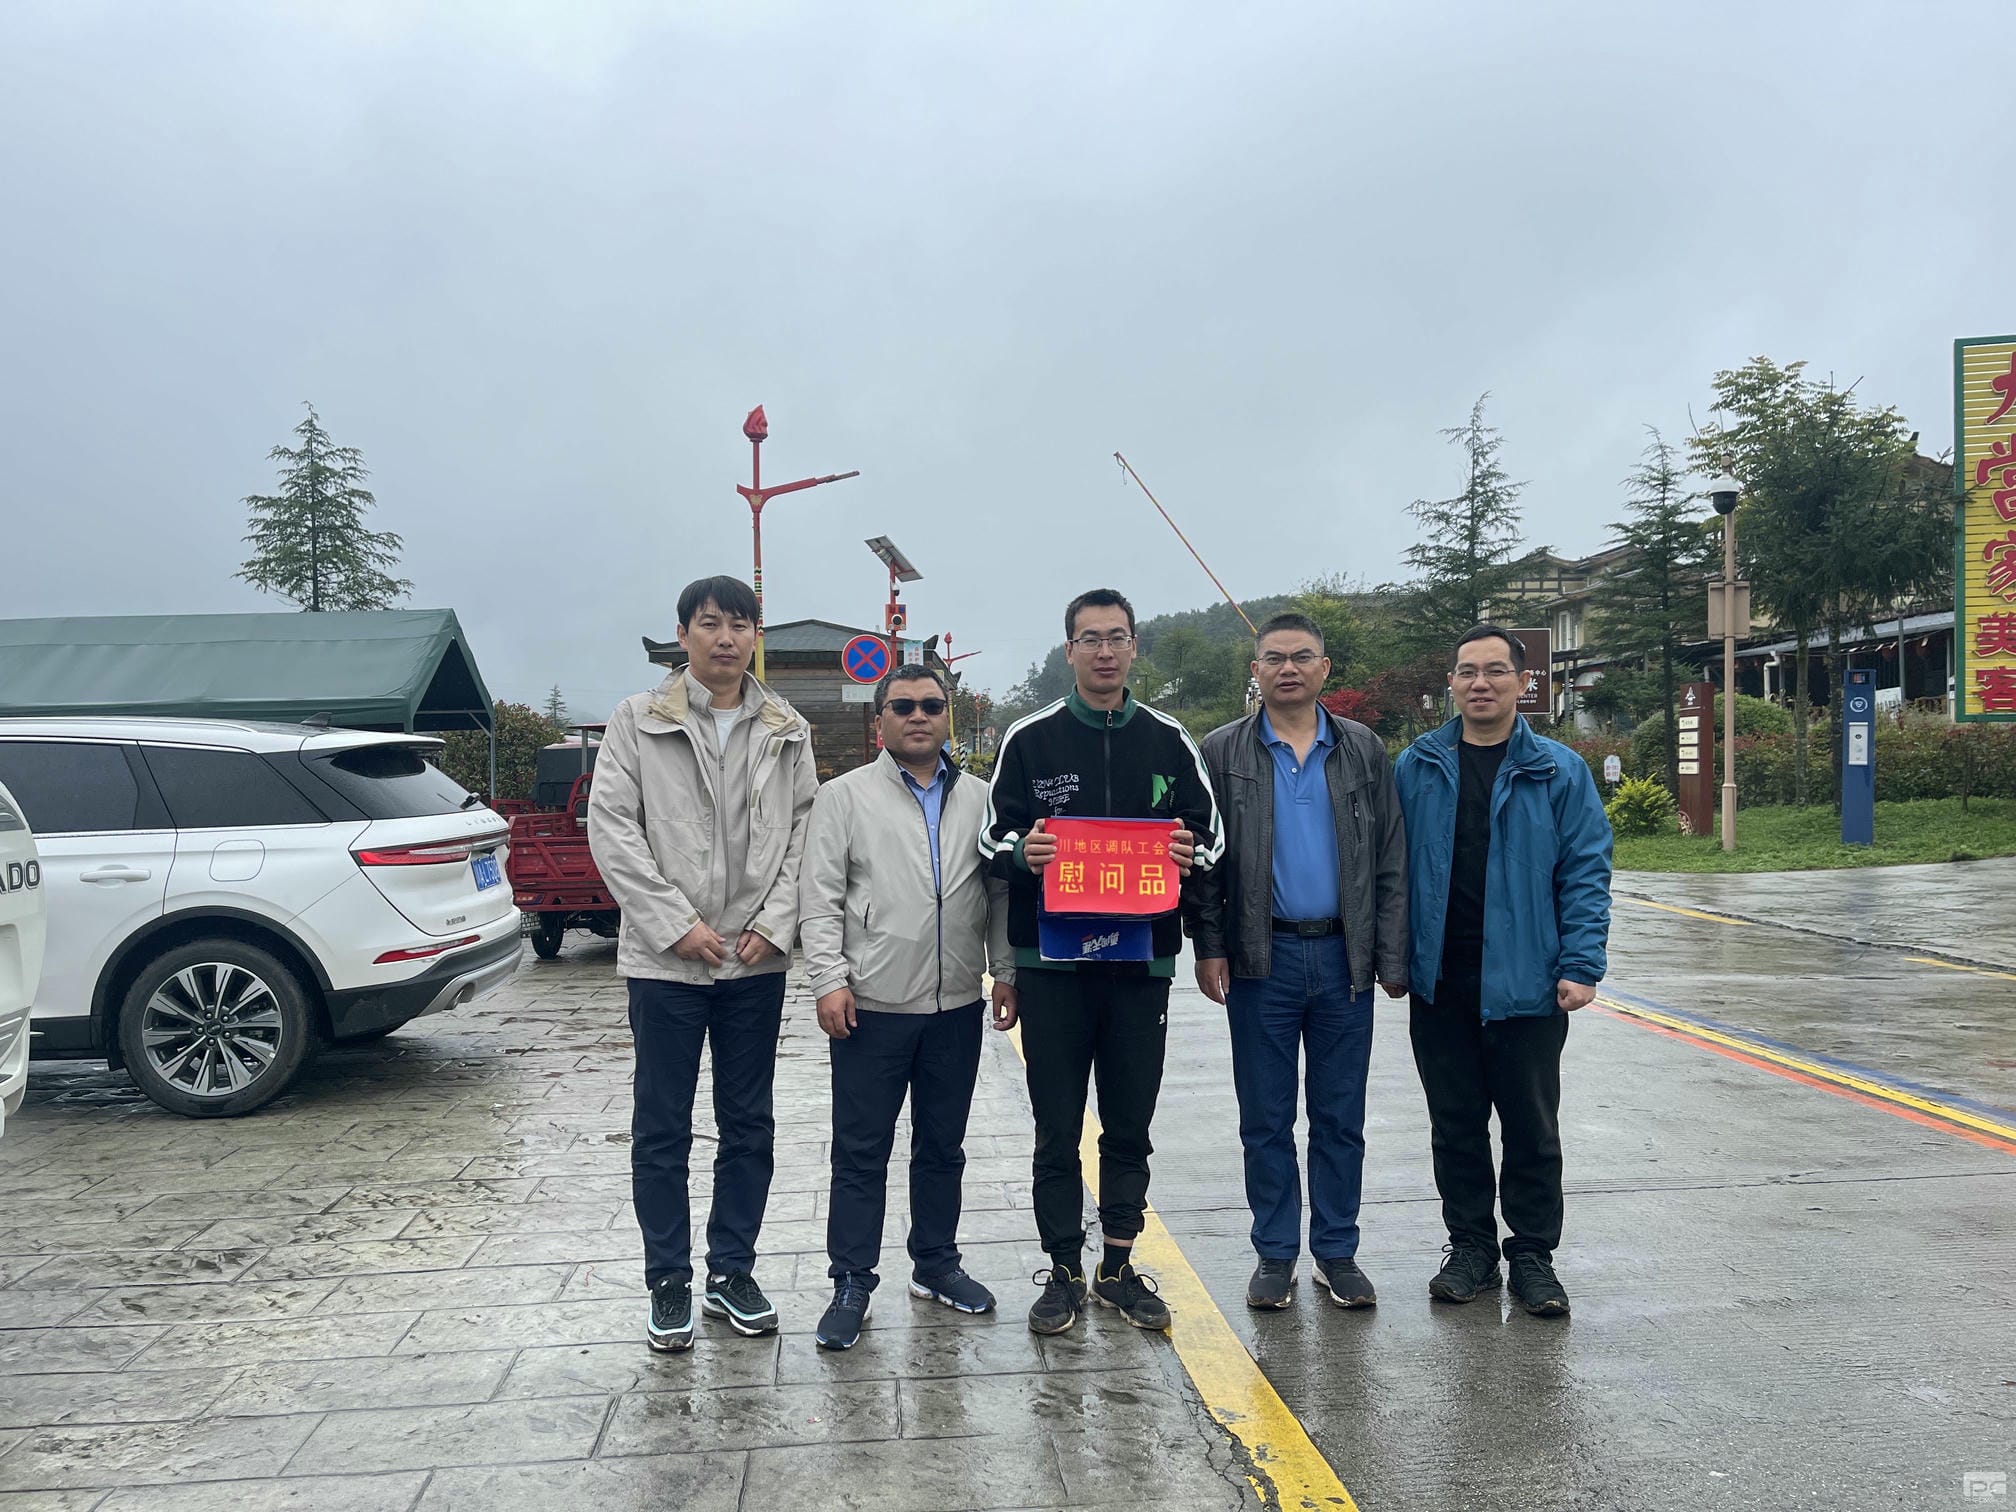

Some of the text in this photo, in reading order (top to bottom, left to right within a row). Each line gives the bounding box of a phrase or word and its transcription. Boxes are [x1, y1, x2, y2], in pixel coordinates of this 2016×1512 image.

[1060, 839, 1166, 856] 川地区调队工会
[1059, 861, 1166, 895] 慰问品
